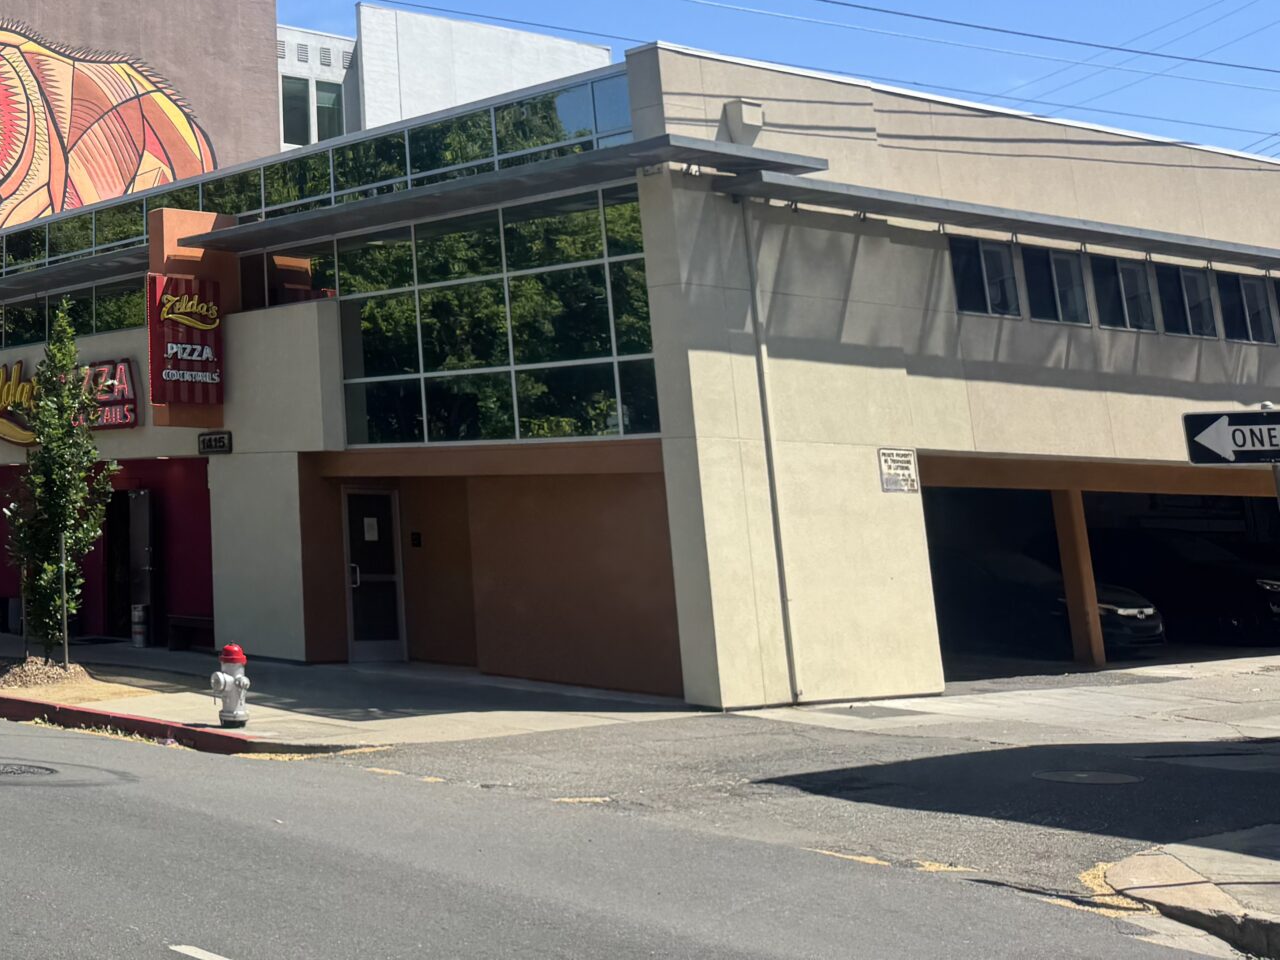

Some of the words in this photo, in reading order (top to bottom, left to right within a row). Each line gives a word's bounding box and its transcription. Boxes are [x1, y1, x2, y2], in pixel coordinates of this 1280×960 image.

[161, 294, 219, 330] Zelda's
[167, 342, 214, 361] PIZZA
[162, 369, 220, 383] COCKTAILS
[1231, 427, 1280, 448] ONE
